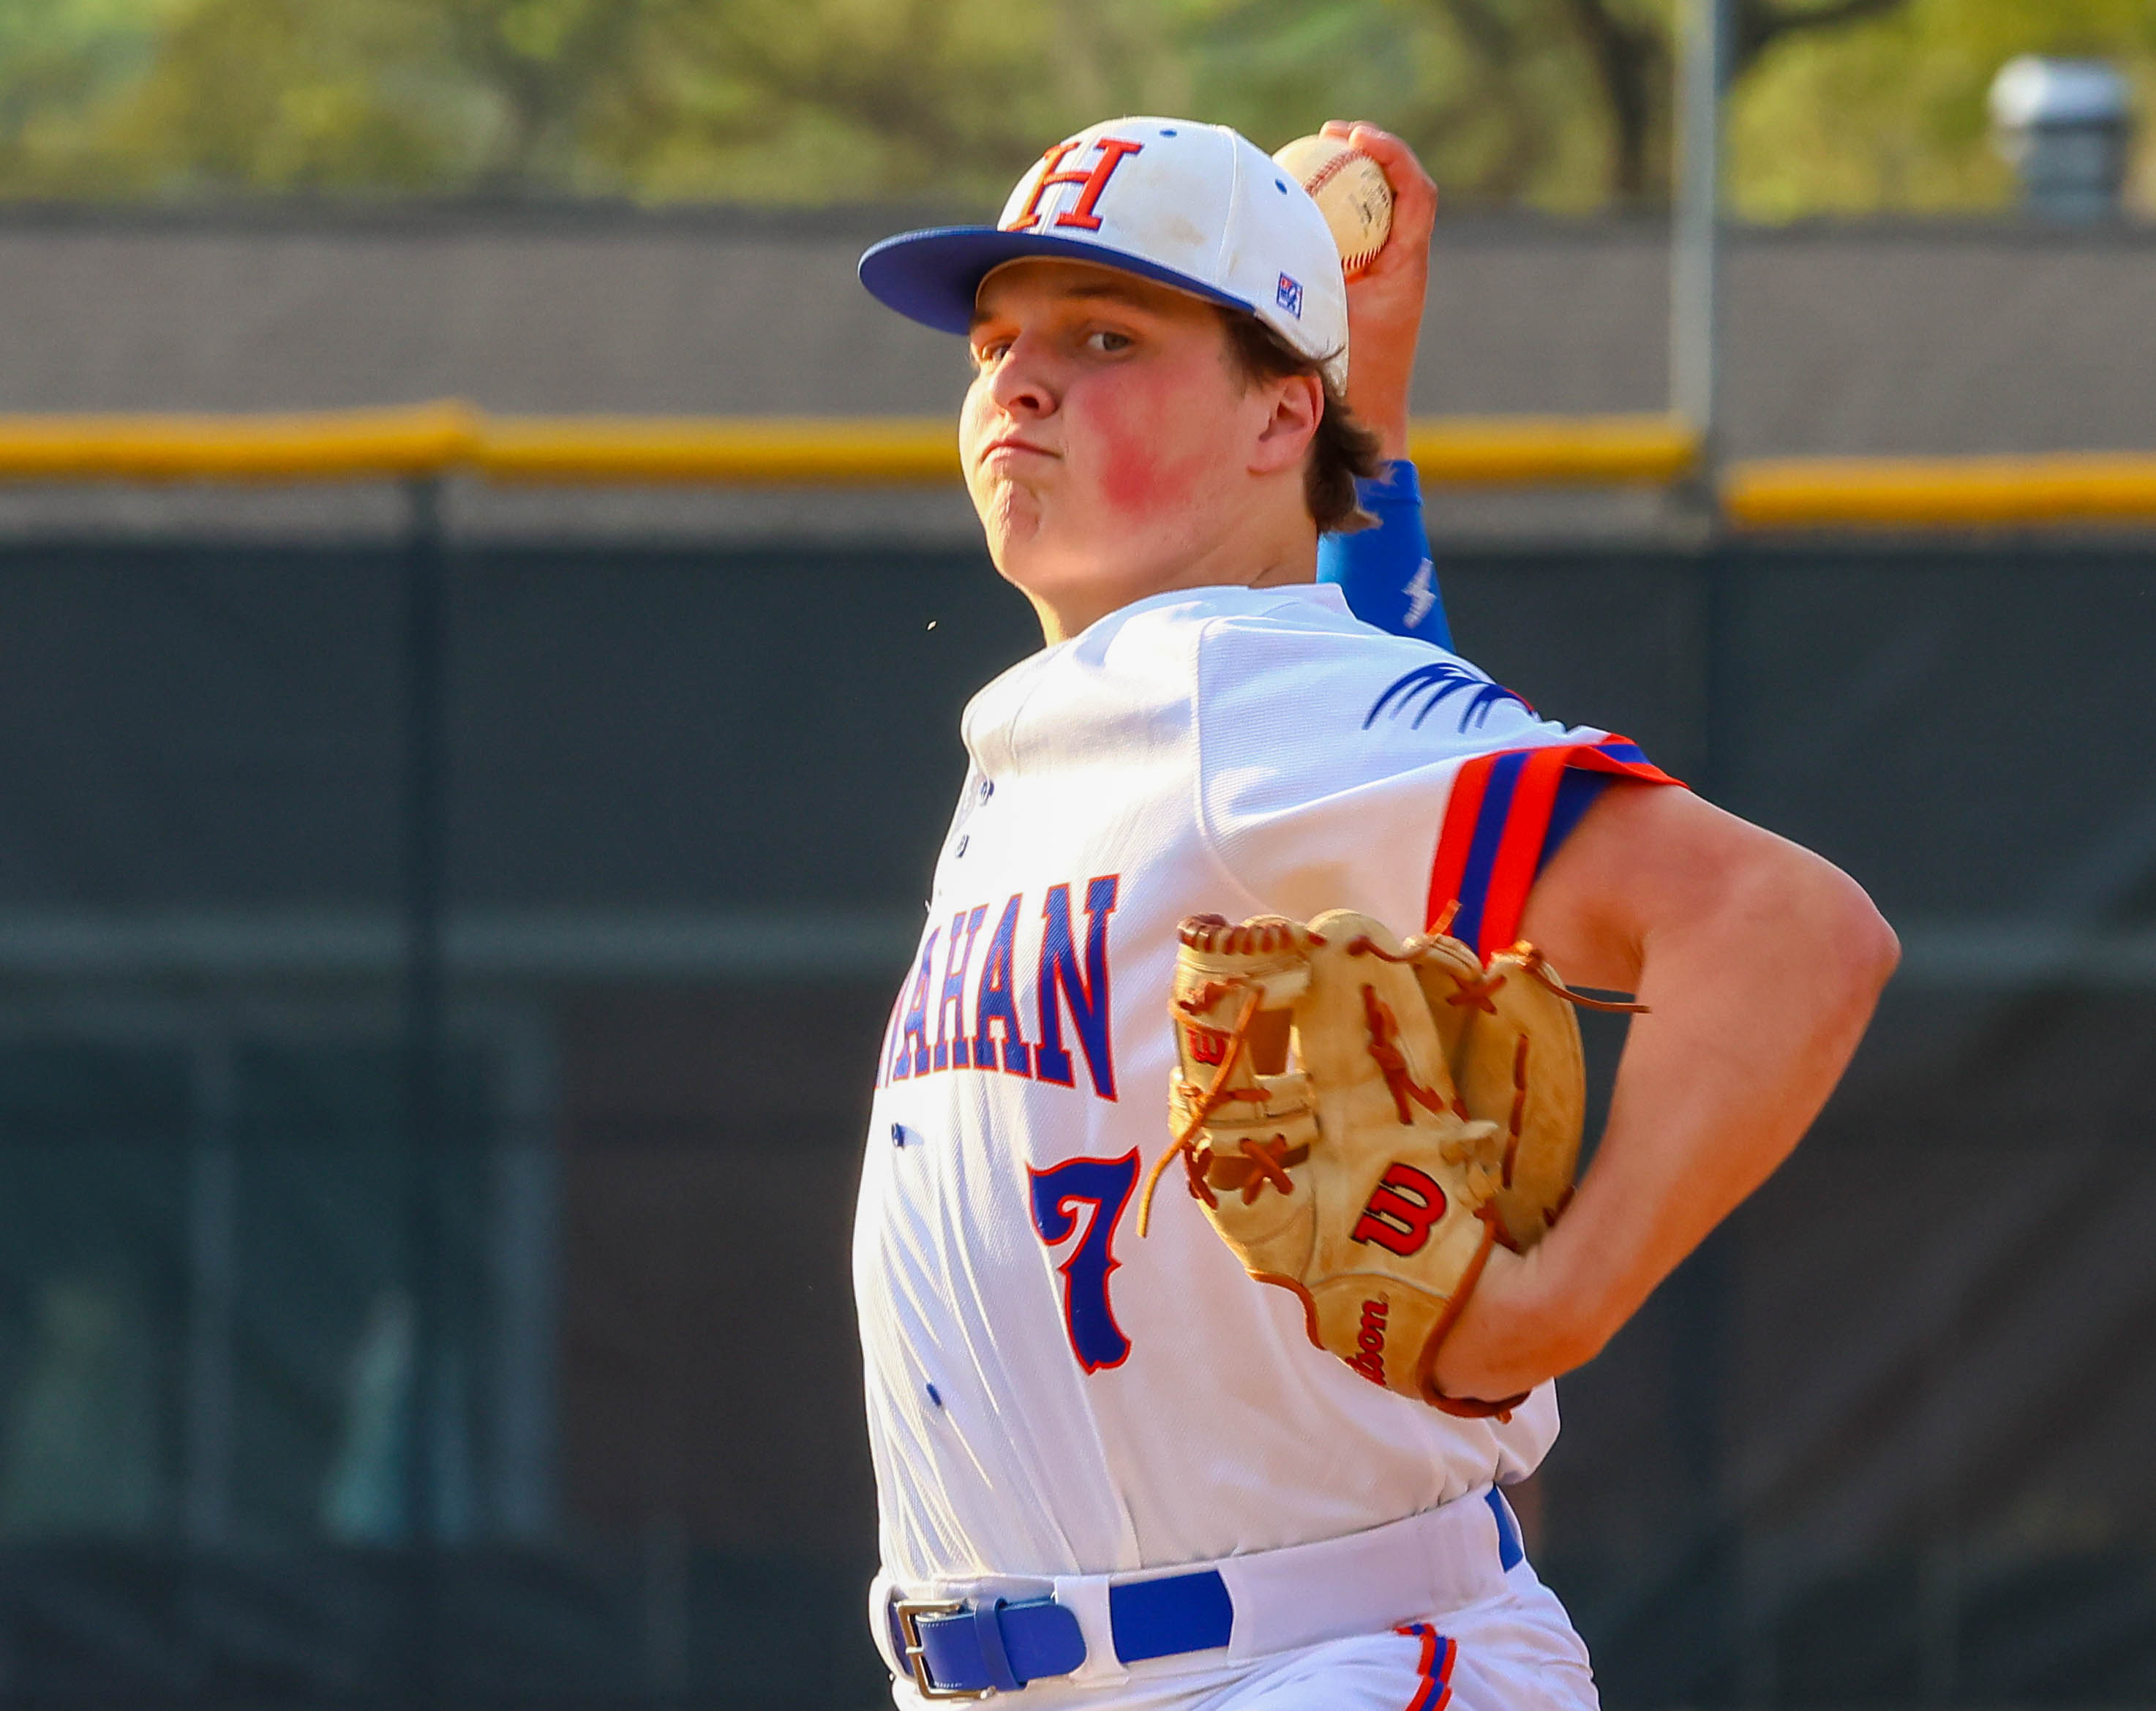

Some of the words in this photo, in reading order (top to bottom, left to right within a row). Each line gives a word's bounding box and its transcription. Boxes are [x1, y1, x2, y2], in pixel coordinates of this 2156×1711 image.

[1006, 137, 1144, 233] H
[1350, 1162, 1447, 1257] W
[1024, 1144, 1141, 1377] 7
